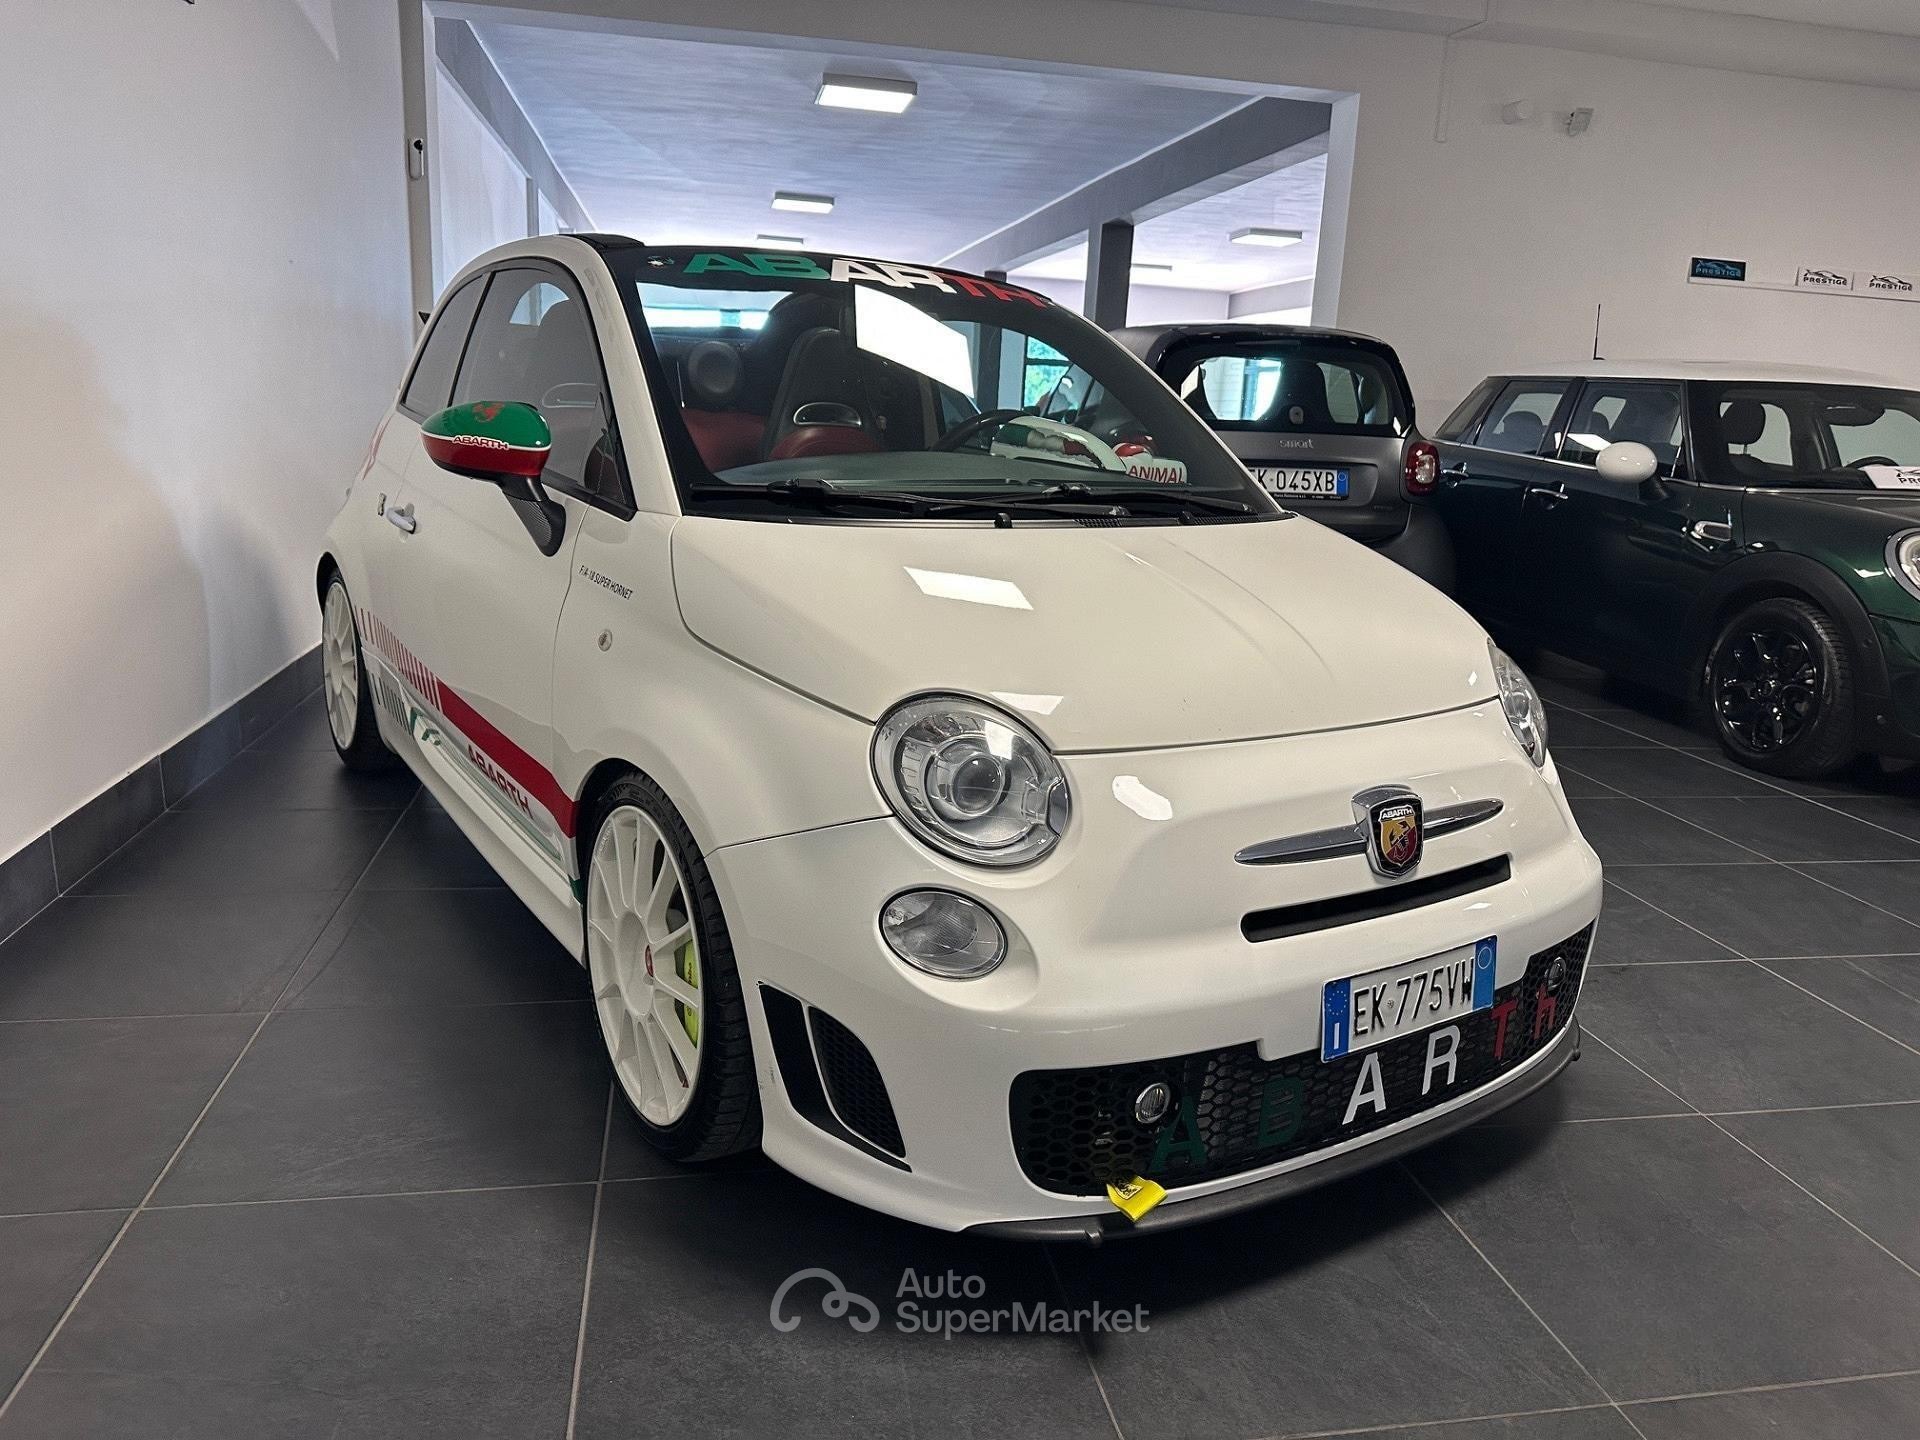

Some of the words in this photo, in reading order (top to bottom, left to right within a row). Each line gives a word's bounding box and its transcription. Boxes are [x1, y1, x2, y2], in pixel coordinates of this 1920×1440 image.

[1695, 266, 1742, 278] PRESTIGE
[683, 252, 1047, 308] ABARTH
[1803, 276, 1848, 287] PRESTIGE
[1869, 282, 1913, 292] PRESTIGE
[452, 436, 510, 450] ABARTH
[1279, 439, 1314, 449] smart
[1128, 465, 1185, 484] ANIMAL
[1276, 470, 1335, 491] 045XB
[593, 573, 611, 590] SUPER
[610, 581, 633, 600] HORNET
[468, 744, 534, 819] ABARTH
[1382, 808, 1413, 820] ABARTH
